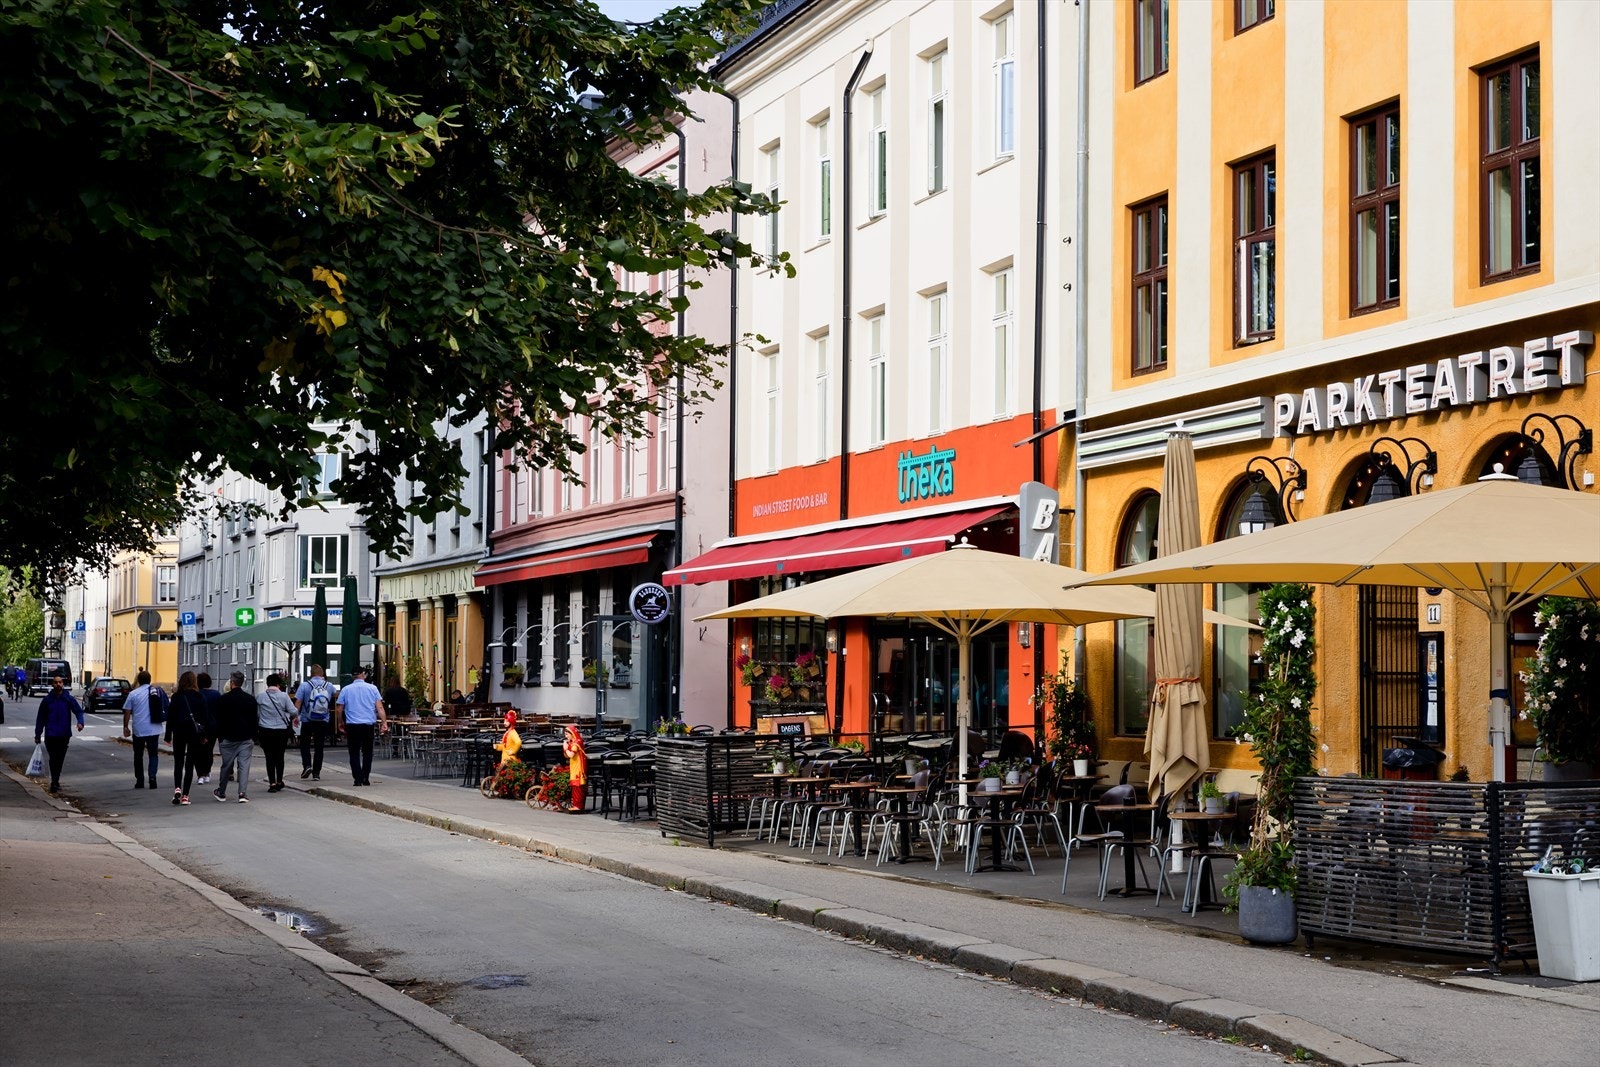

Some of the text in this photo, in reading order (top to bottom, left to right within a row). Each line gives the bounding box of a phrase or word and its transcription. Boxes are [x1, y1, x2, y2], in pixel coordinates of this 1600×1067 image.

[1274, 330, 1590, 438] PARKTEATRET
[898, 444, 956, 503] theka
[752, 492, 828, 517] INDIAN STREET FOOD & BAR
[389, 566, 476, 599] VILLA PARADISO
[184, 613, 192, 624] P
[1429, 607, 1437, 620] 11
[780, 725, 801, 733] DAGENS
